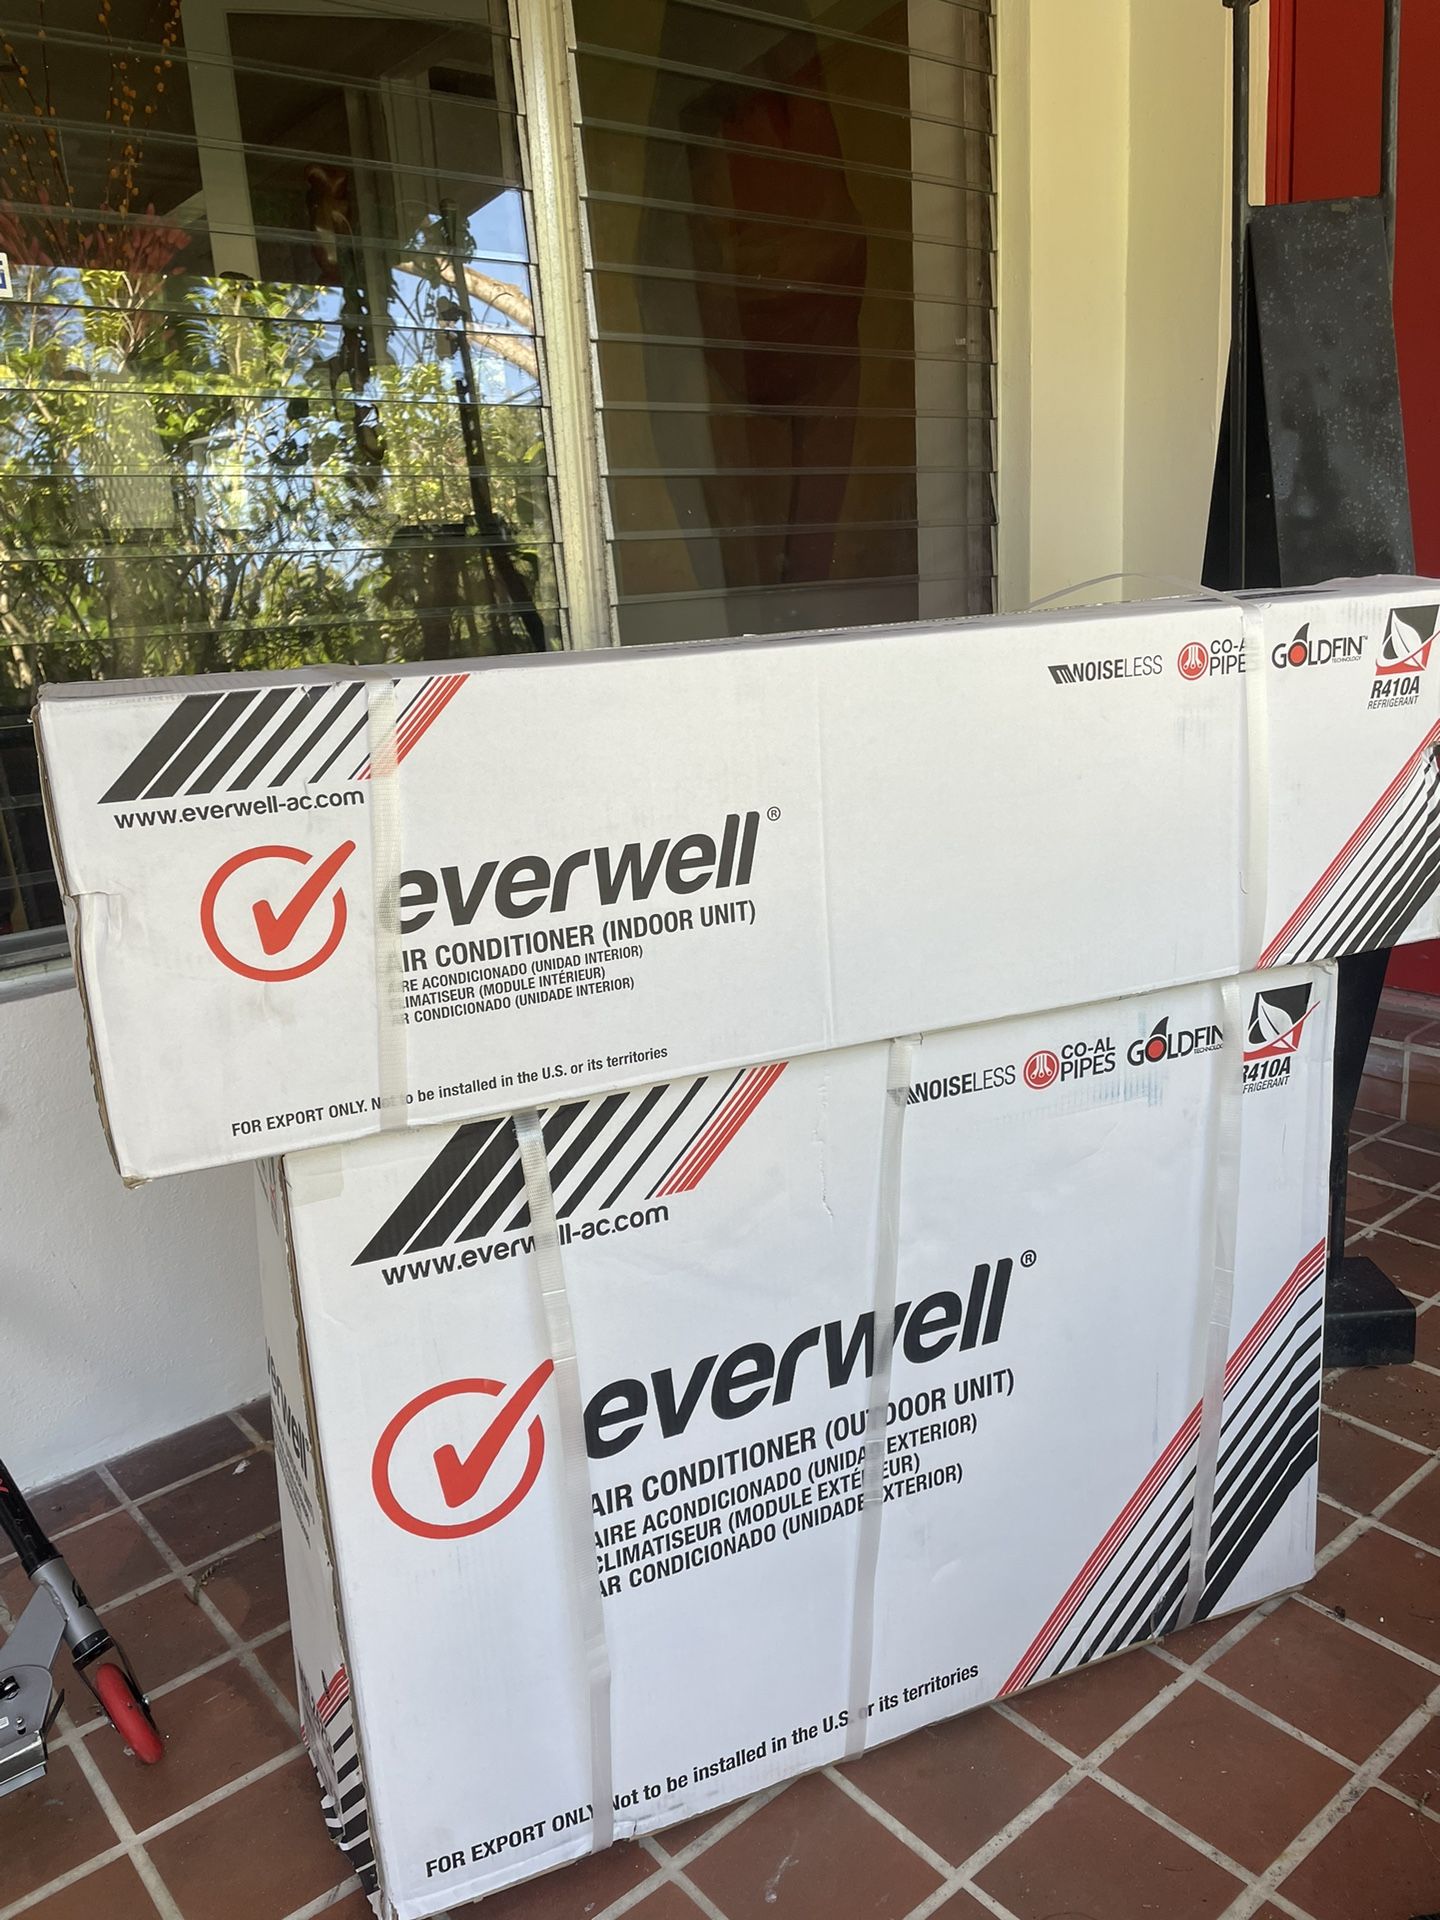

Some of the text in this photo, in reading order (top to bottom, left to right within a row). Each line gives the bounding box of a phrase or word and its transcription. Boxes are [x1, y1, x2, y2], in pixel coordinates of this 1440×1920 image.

[1073, 654, 1163, 682] NOISELESS
[1209, 654, 1246, 676] PIPE
[1210, 638, 1246, 654] CO-A
[1367, 695, 1420, 710] REFRIGERANT
[1370, 675, 1420, 699] R410A
[114, 790, 365, 830] www.everwell-ac.com
[400, 810, 761, 935] everwell
[402, 899, 756, 972] IR CONDITIONER (INDOOR UNIT)
[402, 944, 644, 993] RE ACONDICIONADO (UNIDAD INTERIOR)
[404, 966, 606, 1009] IMATISEUR (MODULE INTÉRIEUR)
[403, 976, 635, 1025] R CONDICIONADO (UNIDADE INTERIOR)
[1059, 1051, 1116, 1082] PIPES
[1061, 1036, 1116, 1060] CO-AL
[231, 1118, 262, 1137] FOR
[266, 1107, 324, 1131] EXPORT
[329, 1099, 368, 1119] ONLY.
[418, 1089, 435, 1103] be
[438, 1075, 498, 1099] installed
[501, 1073, 514, 1087] in
[517, 1068, 539, 1085] the
[541, 1064, 567, 1080] U.S.
[570, 1062, 584, 1075] or
[587, 1056, 603, 1072] its
[606, 1046, 669, 1068] territories
[915, 1064, 1016, 1103] NOISELESS
[1243, 1075, 1291, 1094] FRIGERANT
[382, 1204, 669, 1286] www.everwll-ac.com
[583, 1257, 1014, 1459] everwell
[591, 1368, 1015, 1517] AIR CONDITIONER (OUDOOR UNIT)
[642, 1467, 802, 1535] ACONDICIONADO
[808, 1445, 866, 1484] (UNIDA
[887, 1413, 978, 1455] EXTERIOR)
[728, 1487, 812, 1534] (MODULE
[817, 1452, 920, 1502] EXTÉEUR)
[629, 1524, 776, 1588] CONDICIONADO
[883, 1463, 963, 1503] XTERIOR)
[425, 1849, 466, 1878] FOR
[470, 1820, 546, 1863] EXPORT
[552, 1804, 593, 1833] ONLY
[612, 1789, 640, 1811] Not
[643, 1784, 661, 1801] to
[666, 1774, 688, 1793] be
[693, 1741, 767, 1783] installed
[771, 1736, 788, 1754] in
[791, 1725, 818, 1745] the
[879, 1694, 899, 1713] its
[902, 1664, 979, 1704] territories
